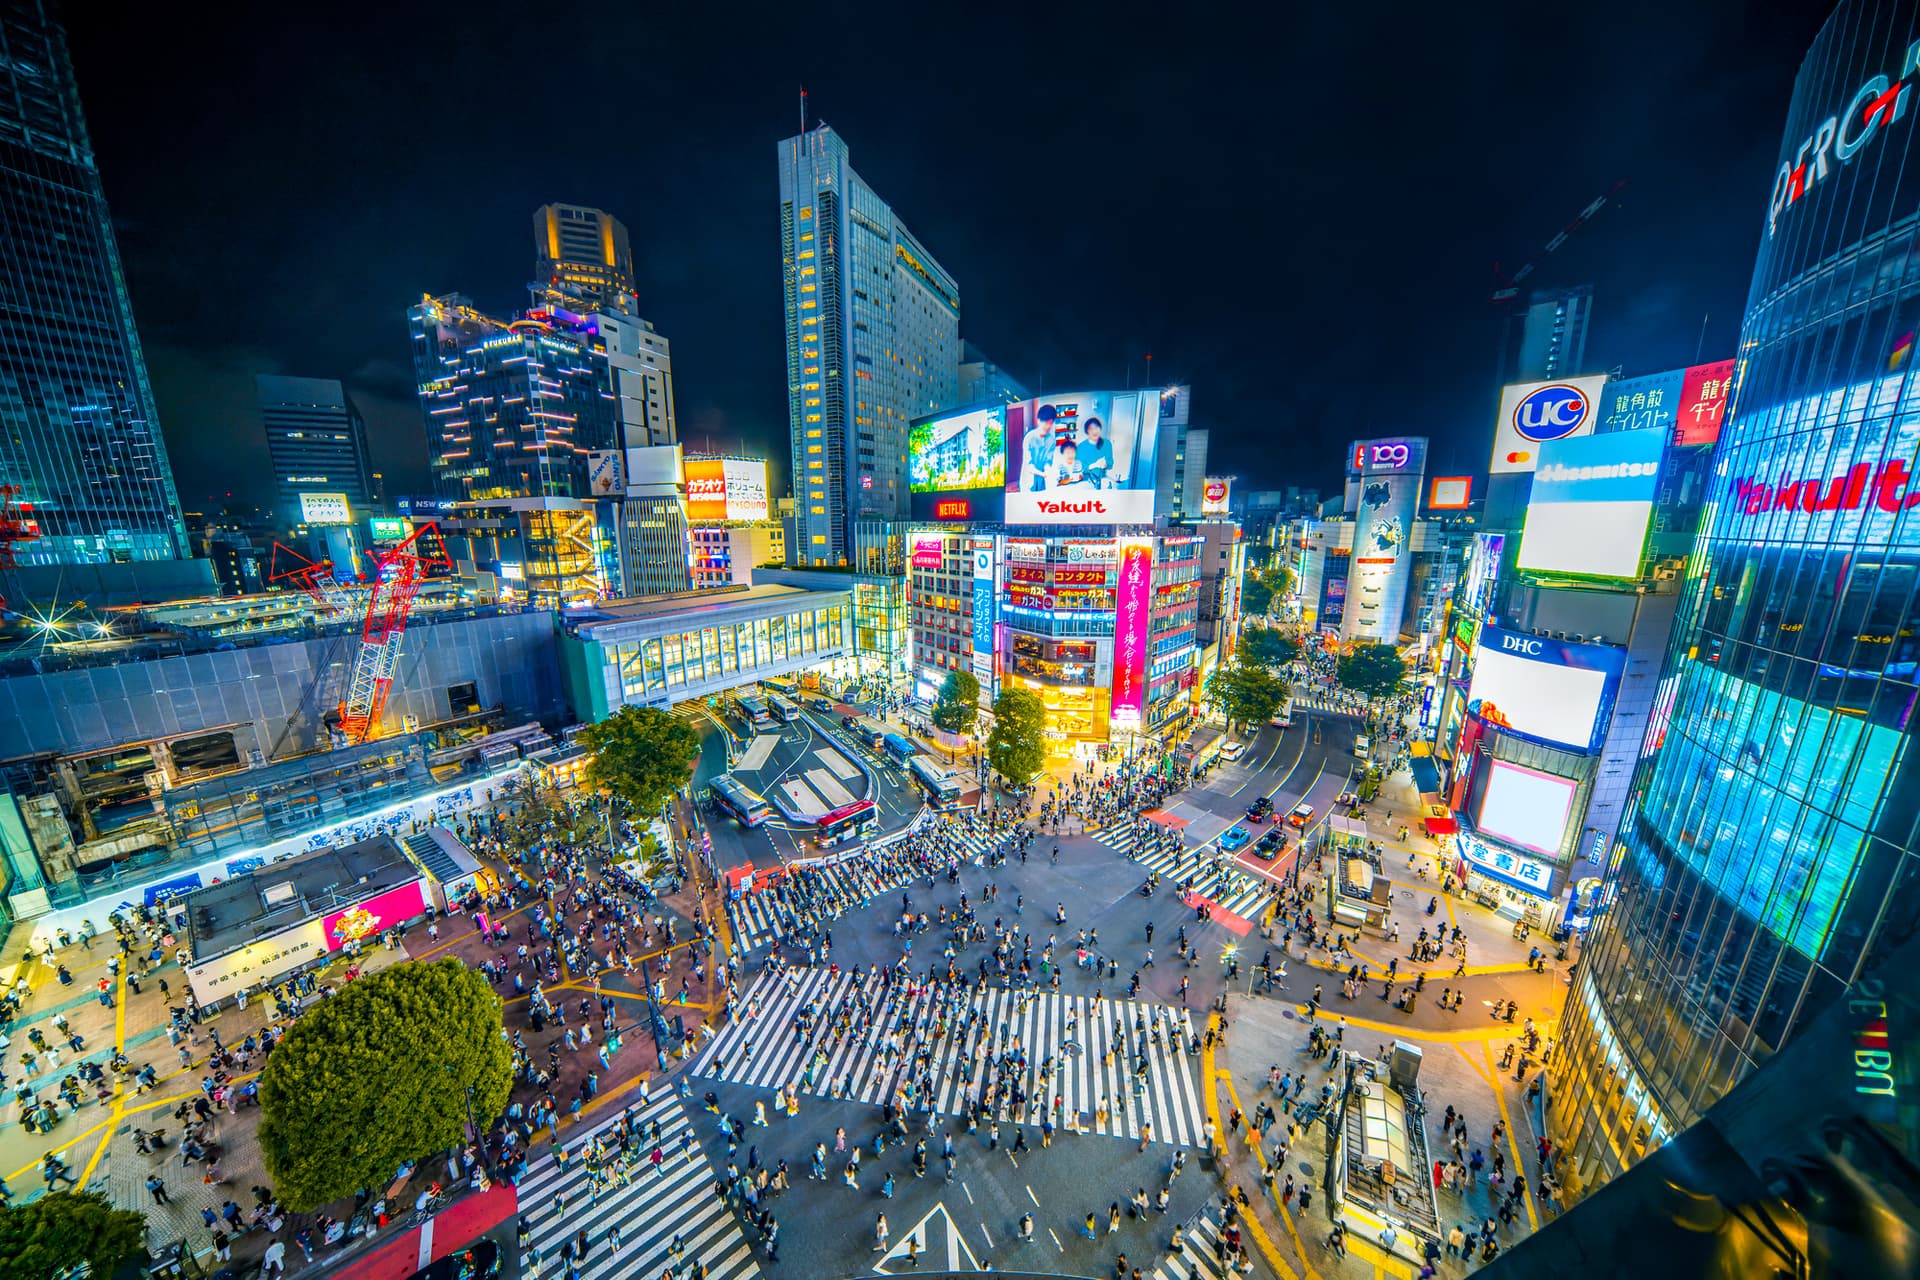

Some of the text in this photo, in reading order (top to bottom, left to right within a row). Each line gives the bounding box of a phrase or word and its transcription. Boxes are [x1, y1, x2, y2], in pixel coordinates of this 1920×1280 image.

[1616, 388, 1663, 412] 龍角散
[1522, 399, 1582, 428] UC
[1606, 410, 1669, 431] ダイレクト
[1372, 445, 1408, 468] 109
[688, 479, 724, 492] カラオケ
[939, 503, 967, 516] NETFLIX
[1037, 500, 1106, 513] Yakult
[1055, 572, 1105, 582] コンタクト
[1088, 588, 1111, 599] ガスト
[1022, 595, 1043, 608] ガスト
[1502, 635, 1543, 655] DHC
